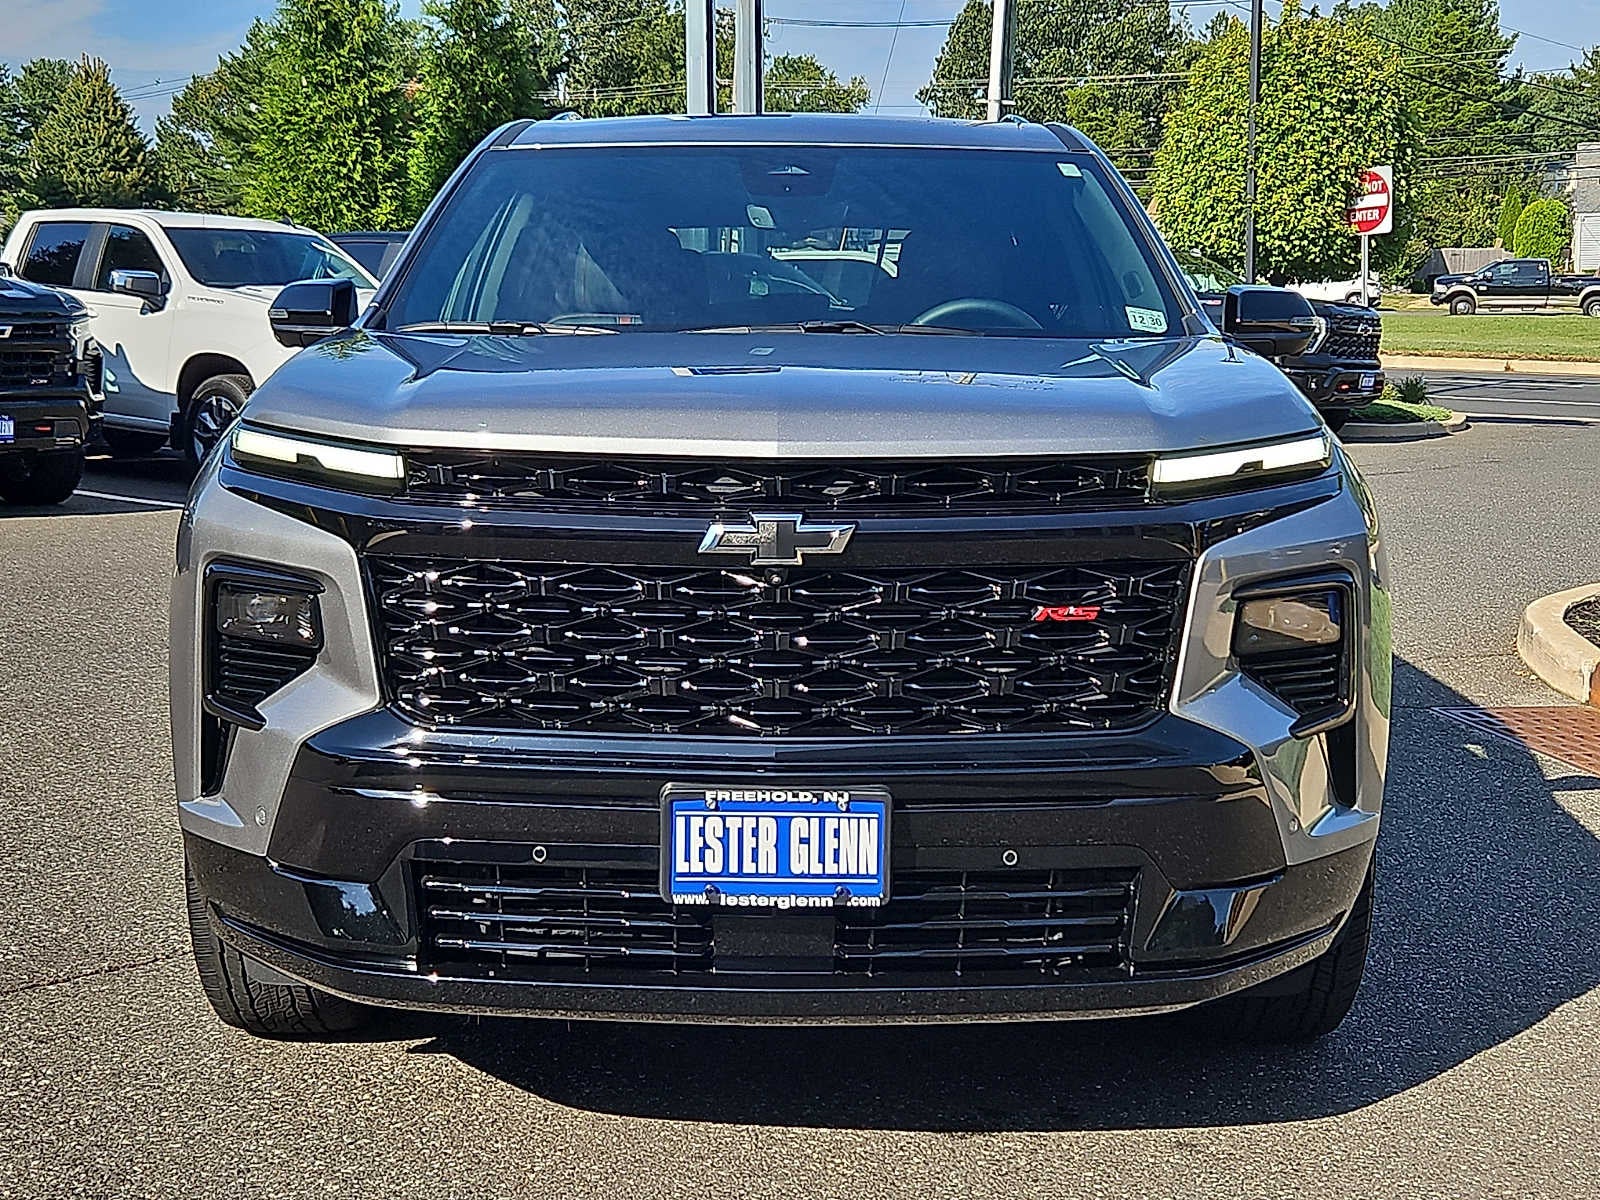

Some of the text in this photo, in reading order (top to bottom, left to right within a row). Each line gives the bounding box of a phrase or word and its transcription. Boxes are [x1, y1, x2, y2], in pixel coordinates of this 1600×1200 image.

[1350, 209, 1379, 222] ENTER
[1132, 314, 1146, 325] 12
[1031, 605, 1101, 621] RS
[705, 791, 849, 804] FREEHOLD, NJ
[675, 816, 878, 875] LESTER GLENN
